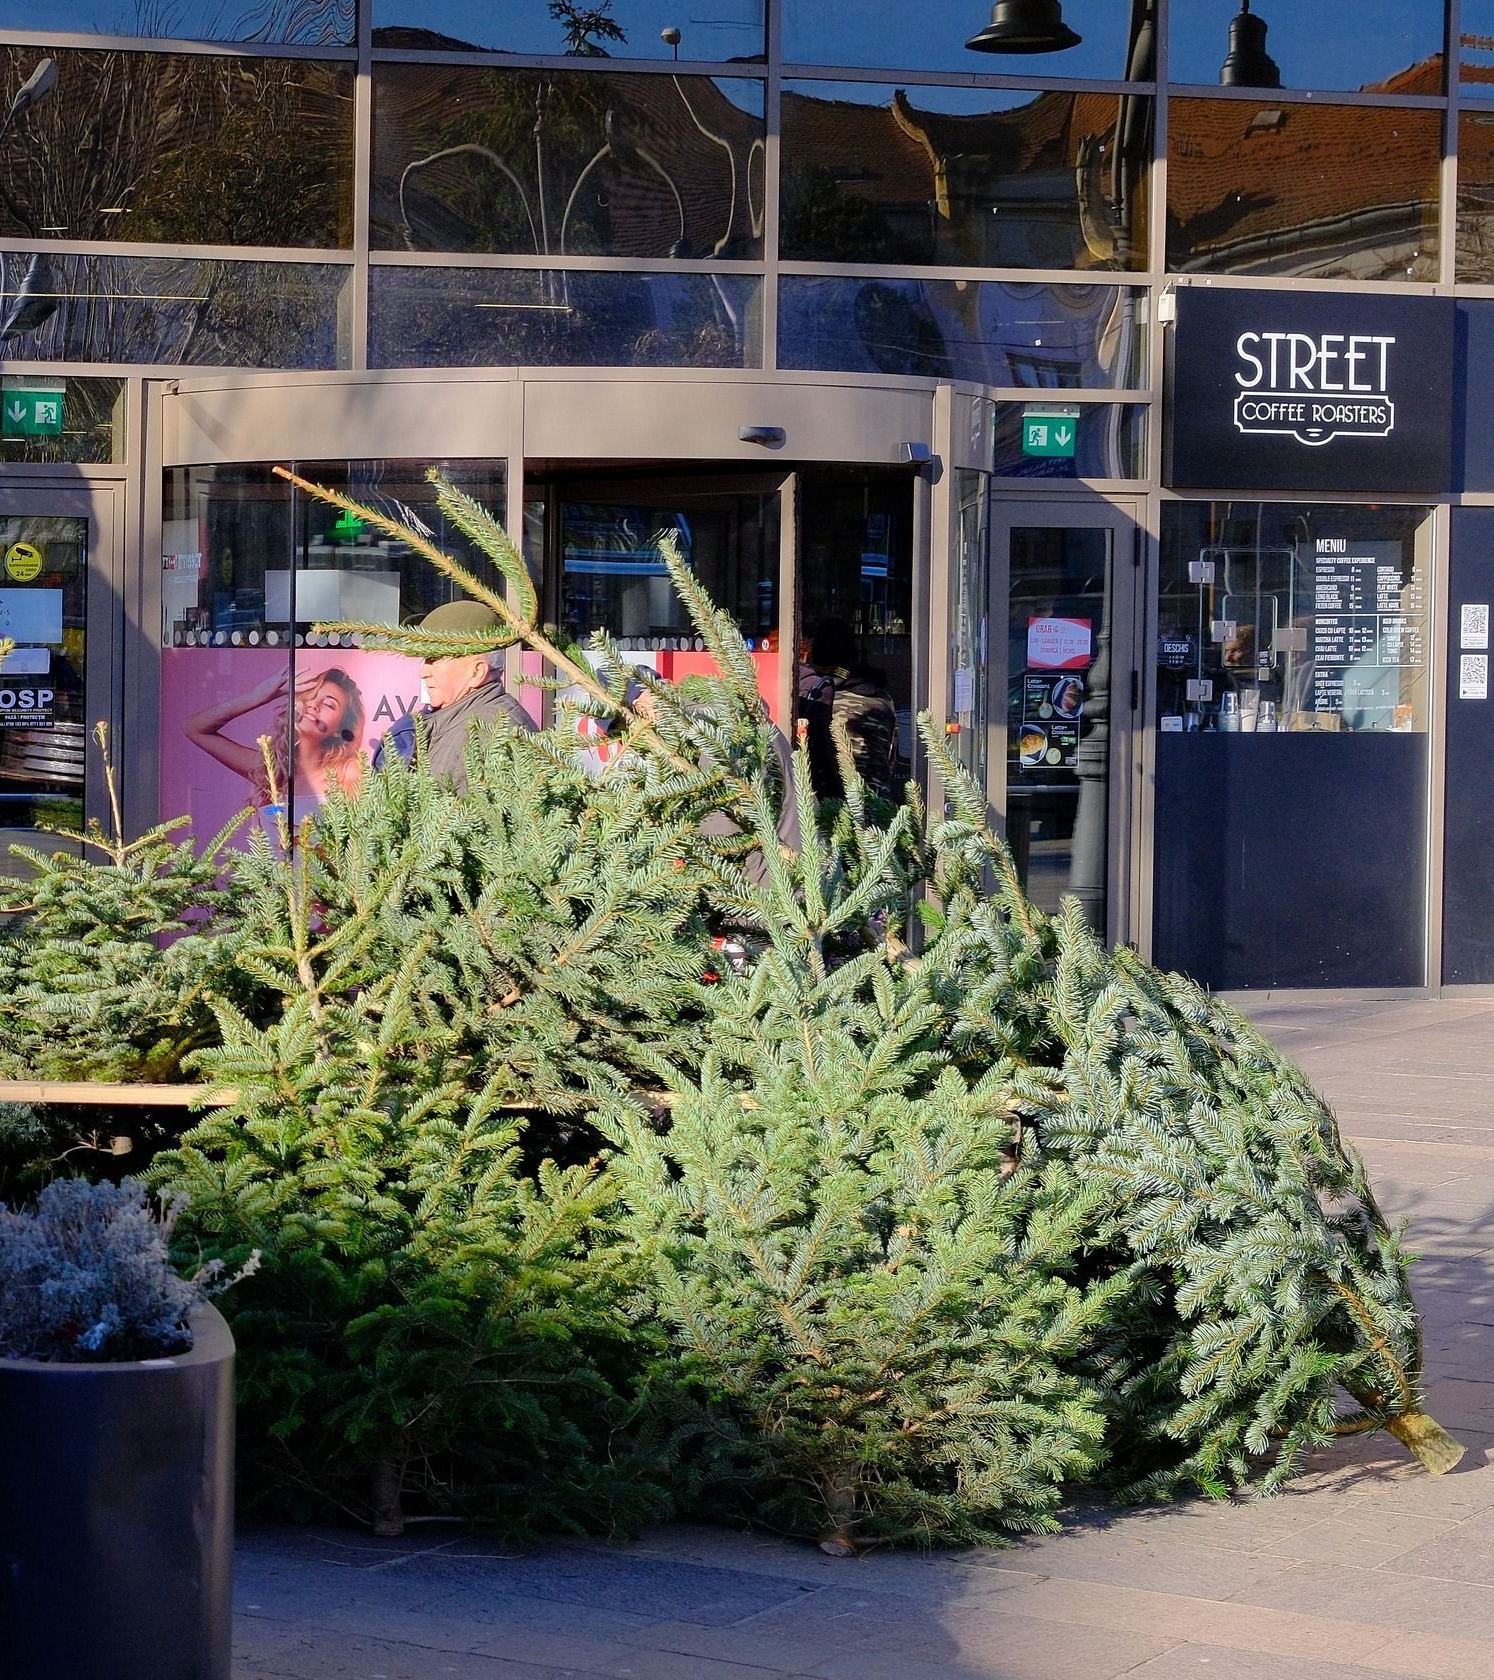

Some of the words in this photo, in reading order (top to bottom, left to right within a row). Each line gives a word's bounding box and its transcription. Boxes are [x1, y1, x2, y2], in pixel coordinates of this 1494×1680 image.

[1234, 331, 1396, 392] STREET
[1242, 402, 1306, 422] COFFEE
[1311, 404, 1387, 424] ROASTERS
[1316, 539, 1346, 553] MENIU
[1164, 644, 1189, 652] DESCHIS
[372, 694, 418, 722] AV
